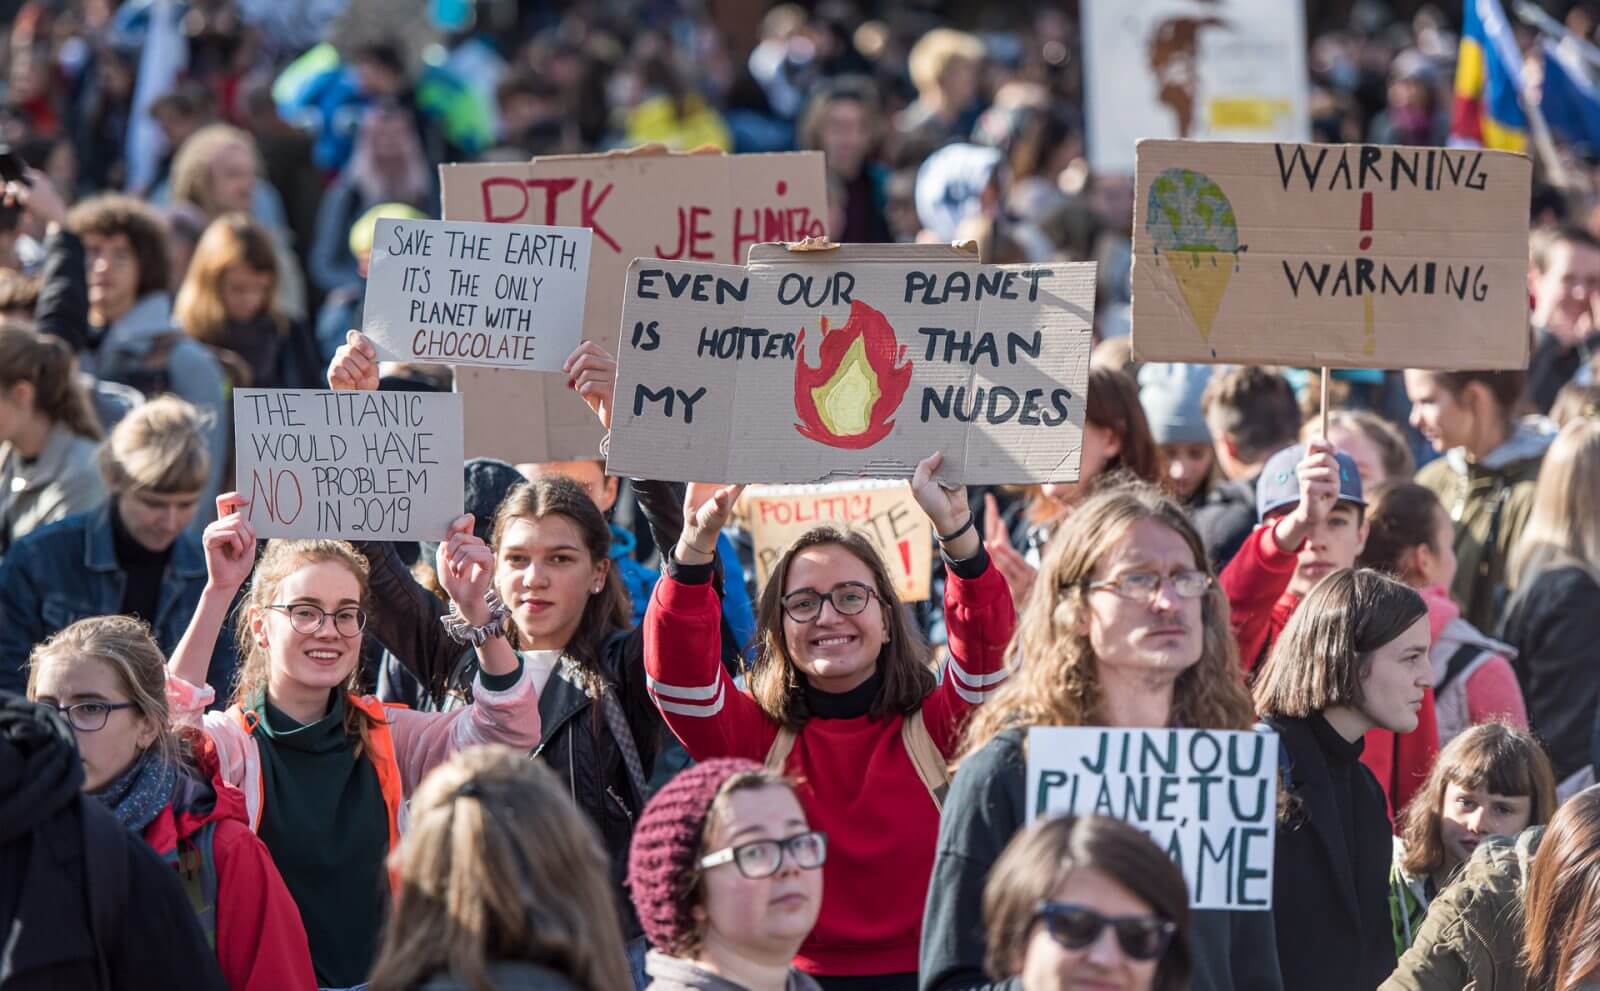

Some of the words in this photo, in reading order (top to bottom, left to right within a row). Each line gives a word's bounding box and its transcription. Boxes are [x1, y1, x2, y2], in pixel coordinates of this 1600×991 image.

[1275, 143, 1488, 192] WARNING
[388, 225, 434, 256] SAVE
[445, 231, 492, 260] THE
[654, 206, 715, 260] JE
[402, 266, 431, 294] IT'S
[449, 269, 480, 297] THE
[495, 274, 543, 302] ONLY
[637, 269, 749, 305] EVEN
[777, 272, 855, 308] OUR
[904, 269, 1054, 304] PLANET
[1282, 257, 1488, 301] WARMING
[409, 300, 478, 327] PLANET
[485, 305, 532, 332] WITH
[412, 329, 536, 361] CHOCOLATE
[631, 320, 661, 351] IS
[697, 326, 796, 360] HOTTER
[918, 327, 1042, 367] THAN
[244, 393, 305, 426] THE
[315, 393, 423, 427] TITANIC
[633, 383, 707, 424] MY
[920, 385, 1072, 427] NUDES
[251, 433, 347, 463] WOULD
[362, 432, 439, 464] HAVE
[248, 467, 303, 525] NO
[312, 466, 428, 497] PROBLEM
[317, 500, 341, 532] IN
[351, 496, 411, 534] 2019
[1080, 731, 1264, 776] JINOU
